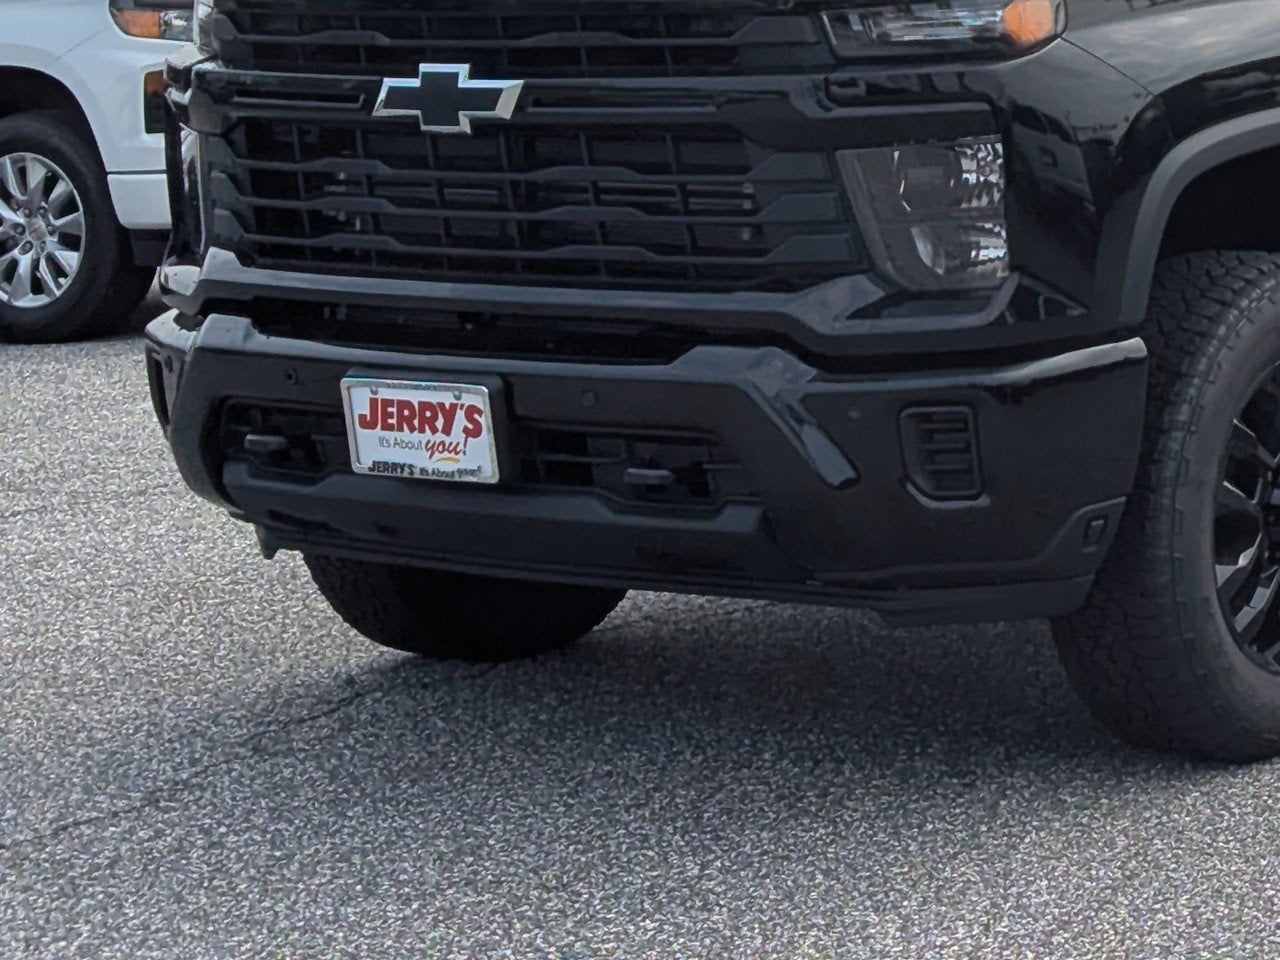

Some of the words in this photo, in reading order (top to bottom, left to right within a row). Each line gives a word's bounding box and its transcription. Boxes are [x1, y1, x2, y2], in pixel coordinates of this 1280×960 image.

[357, 396, 484, 439] JERRY'S
[393, 436, 423, 451] About
[424, 434, 469, 460] you!
